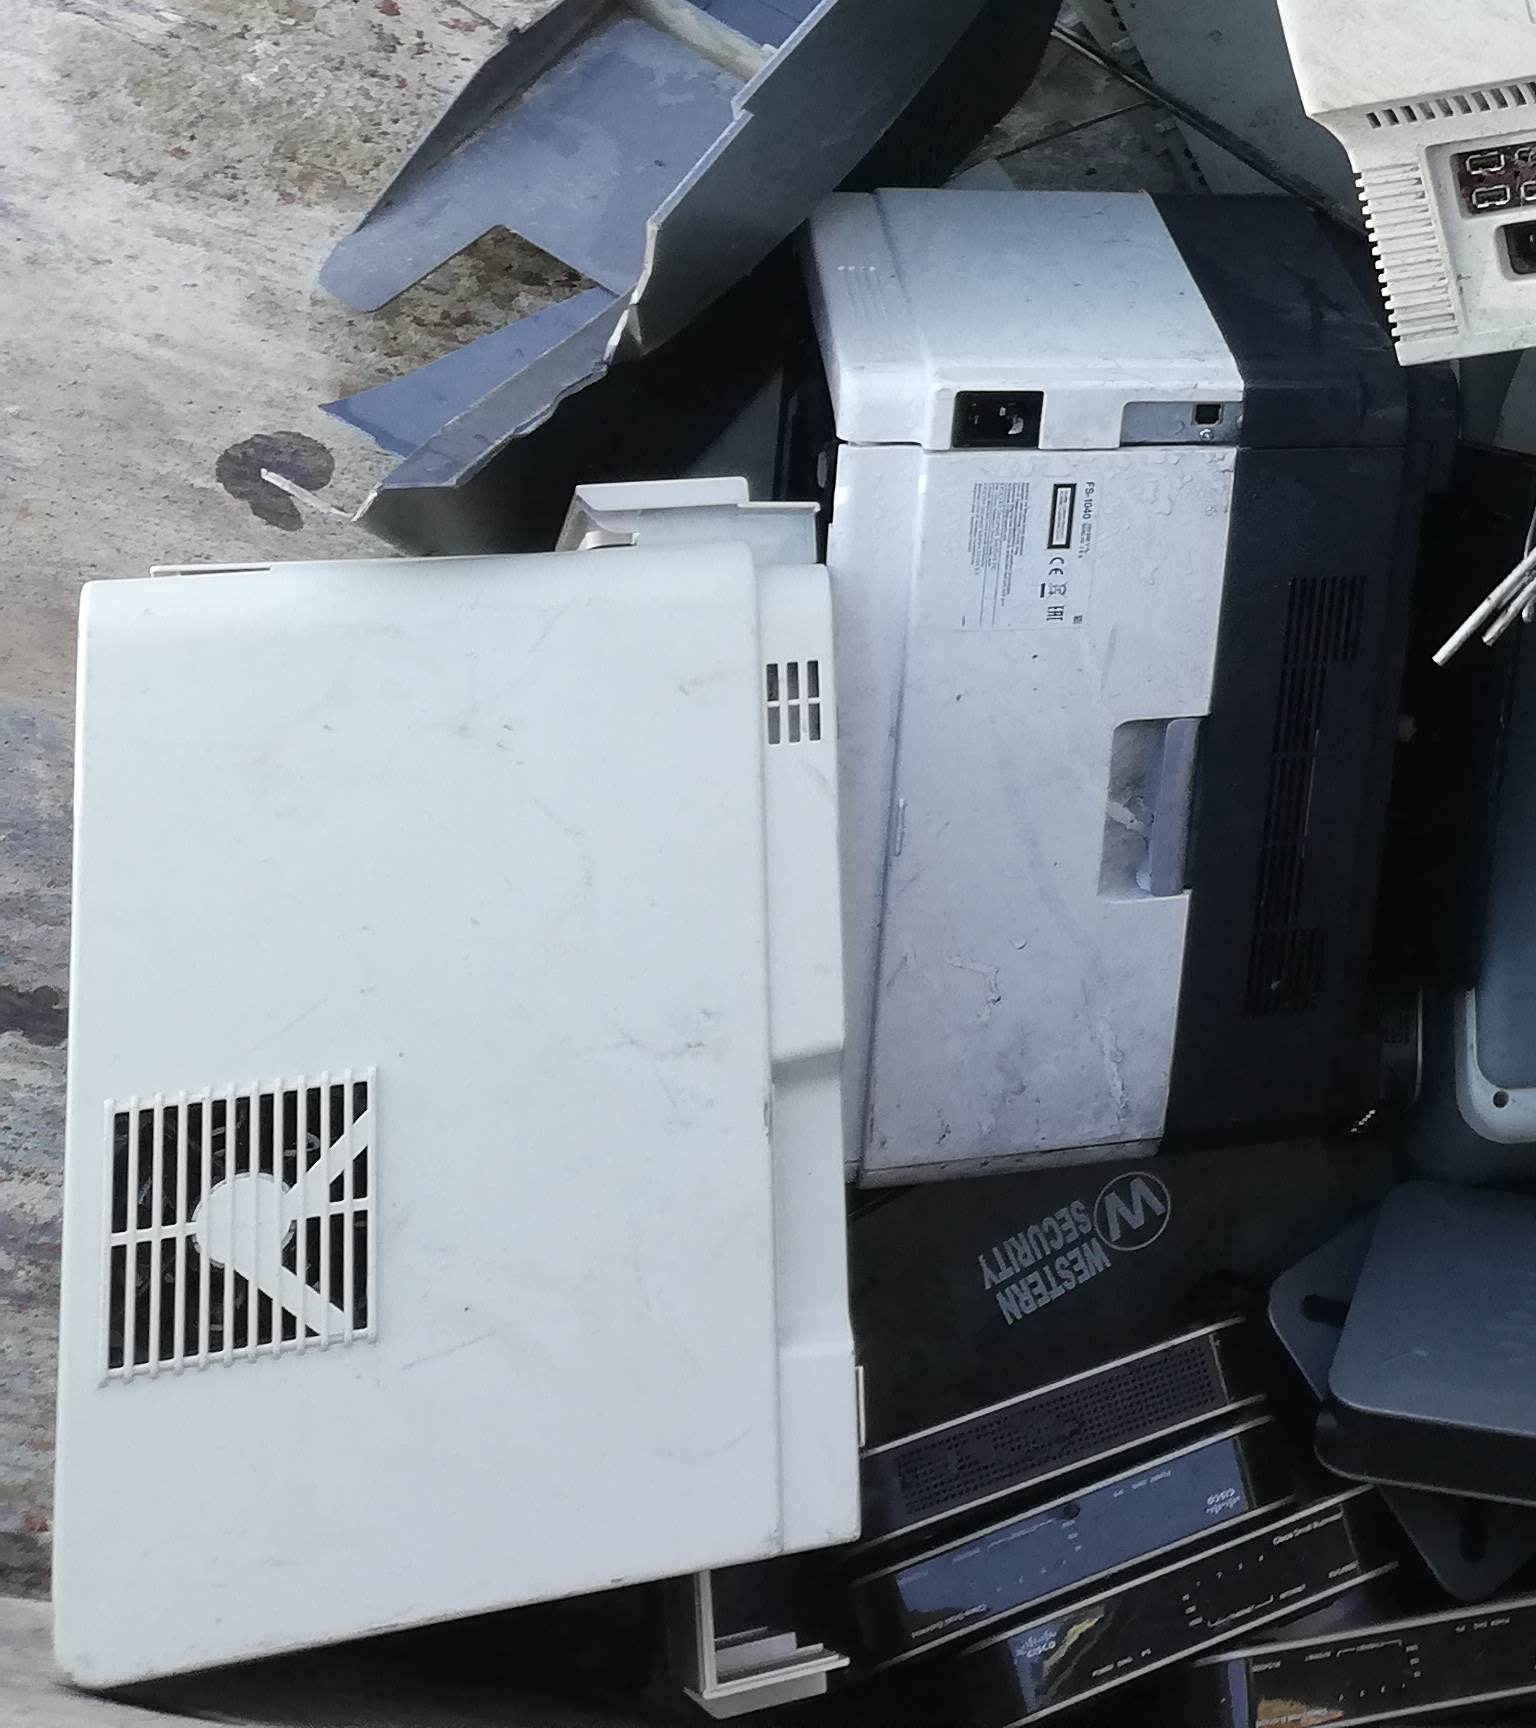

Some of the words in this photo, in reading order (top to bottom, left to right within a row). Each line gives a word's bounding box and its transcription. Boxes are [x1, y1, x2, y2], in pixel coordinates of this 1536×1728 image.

[1082, 481, 1095, 520] FS-1040
[976, 1199, 1096, 1290] SECURITY
[994, 1236, 1113, 1326] WESTERN
[1205, 1487, 1236, 1505] CISCO
[1025, 1640, 1057, 1658] CISCO
